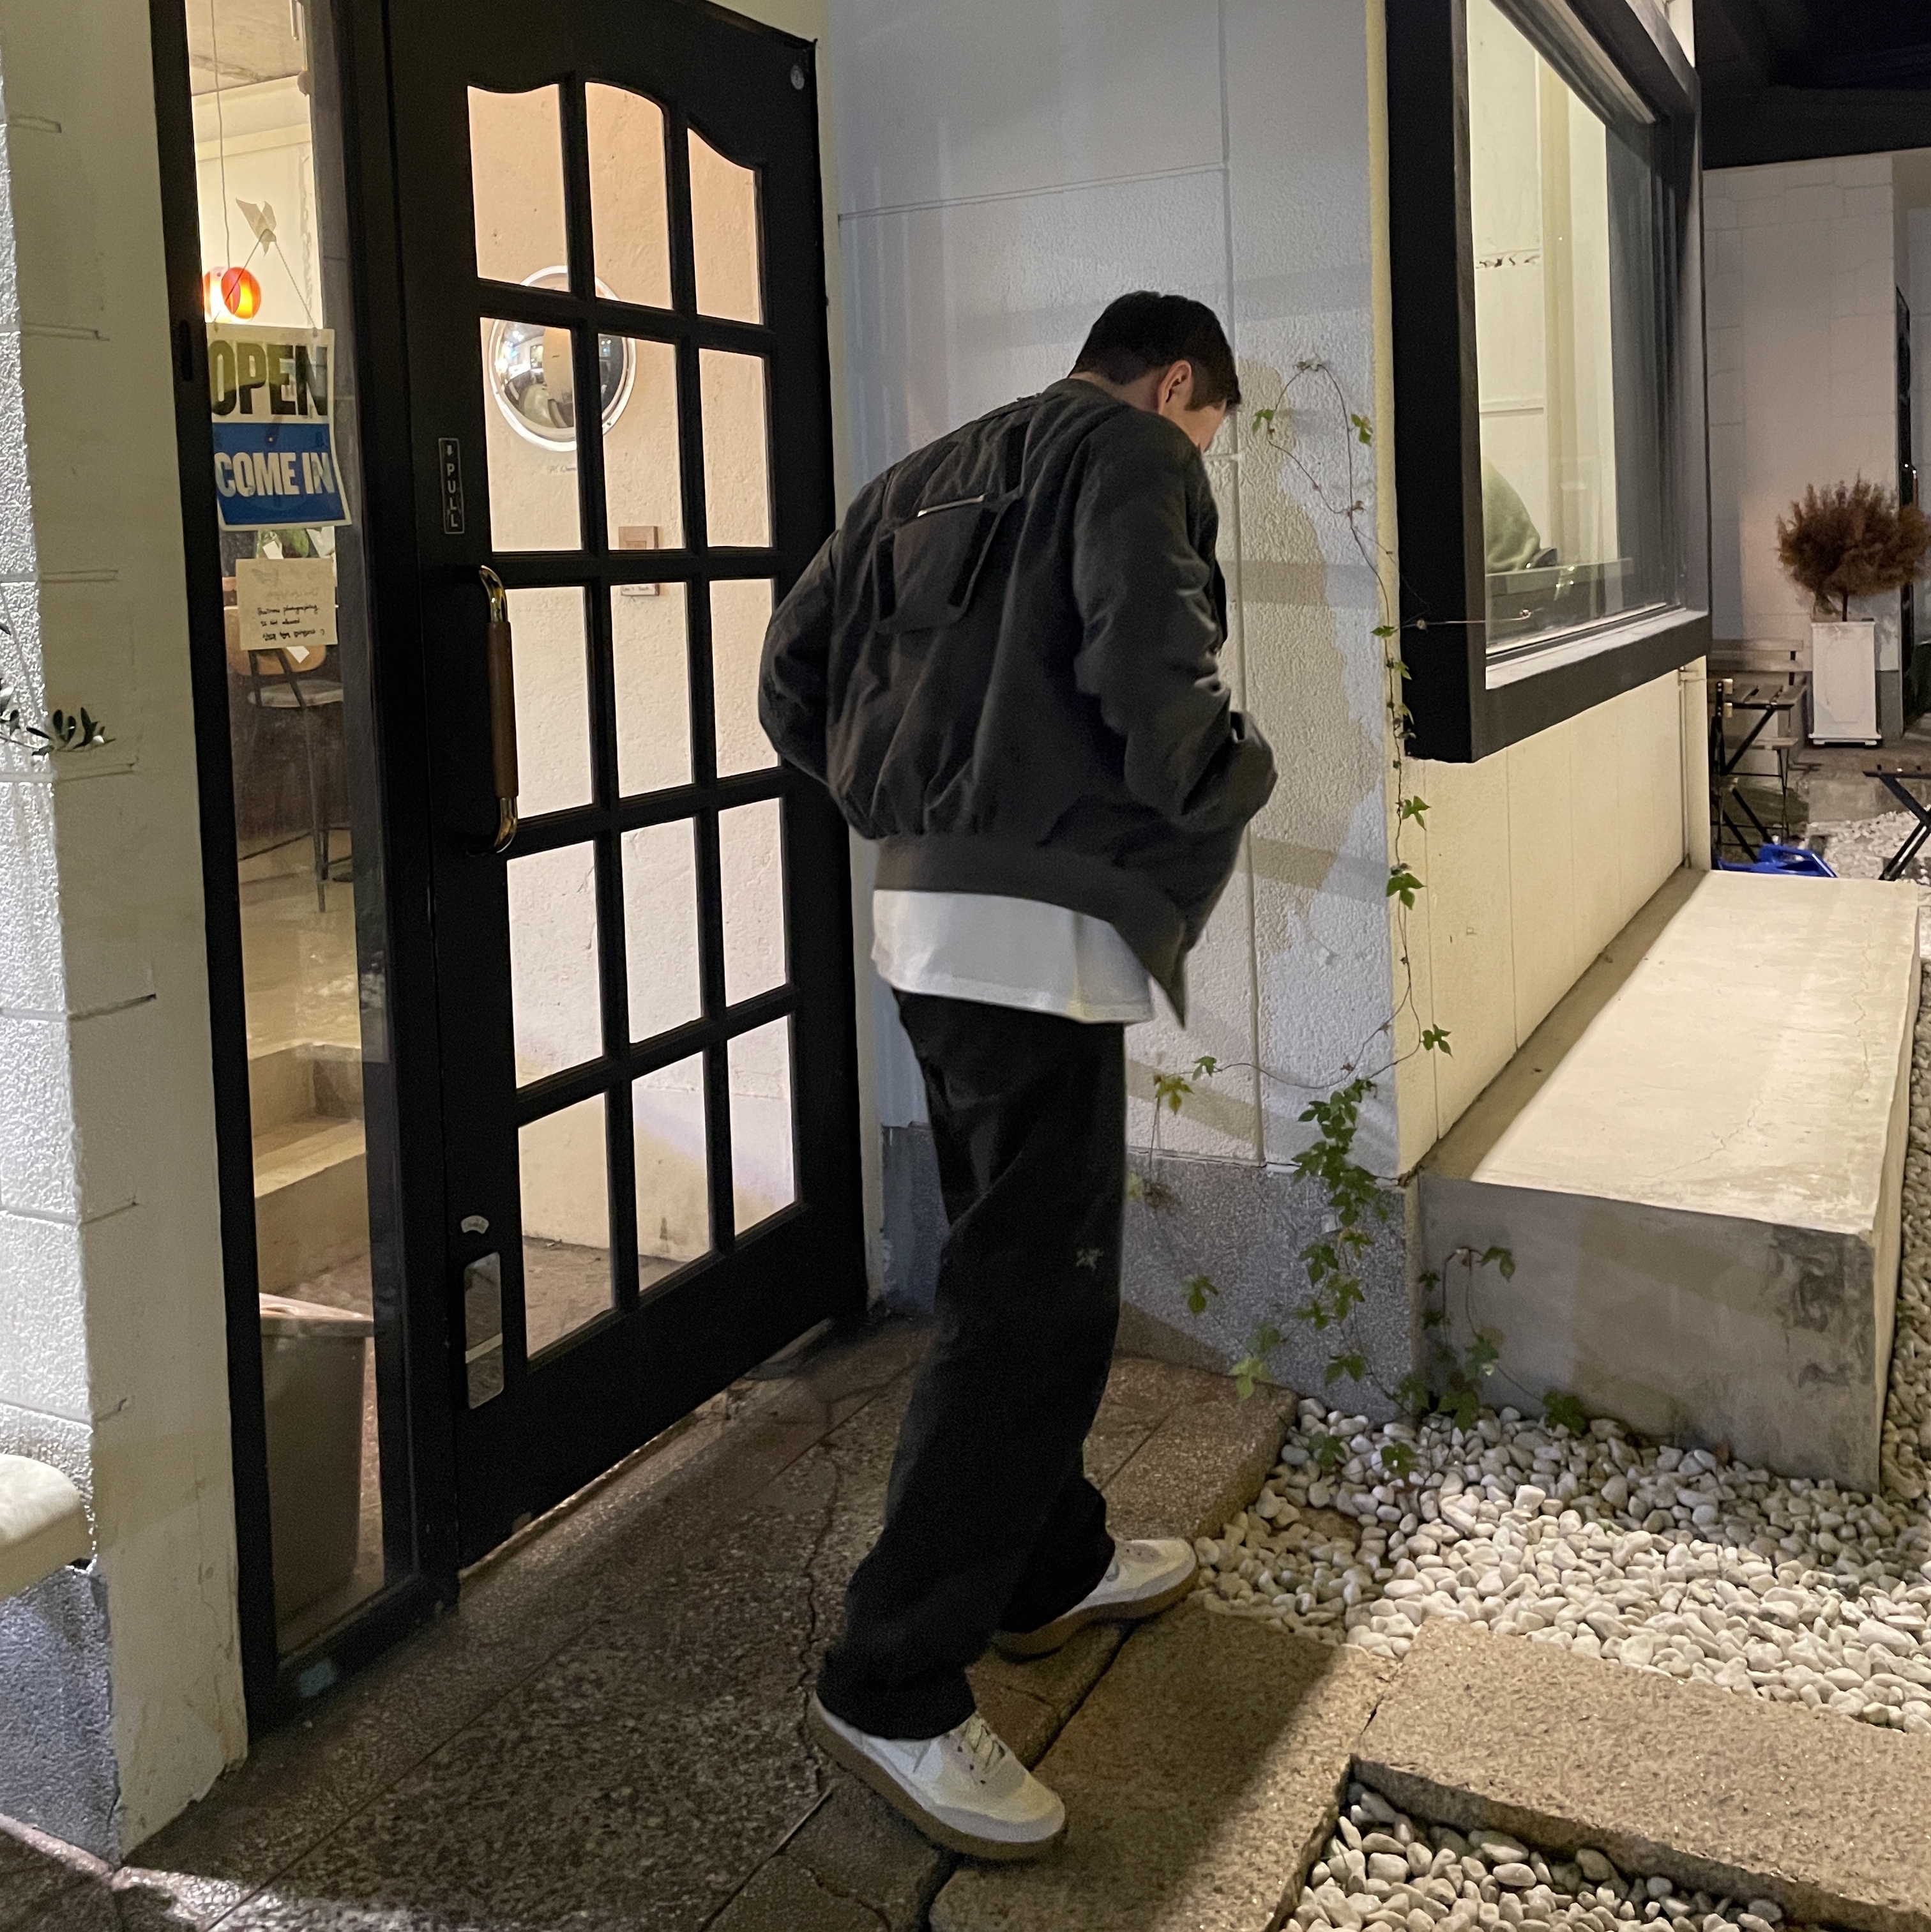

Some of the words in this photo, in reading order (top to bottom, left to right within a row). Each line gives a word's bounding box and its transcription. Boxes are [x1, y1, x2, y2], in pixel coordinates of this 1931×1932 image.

[208, 340, 327, 416] OPEN
[215, 452, 299, 498] COME
[301, 452, 335, 494] IN
[446, 463, 458, 528] PULL
